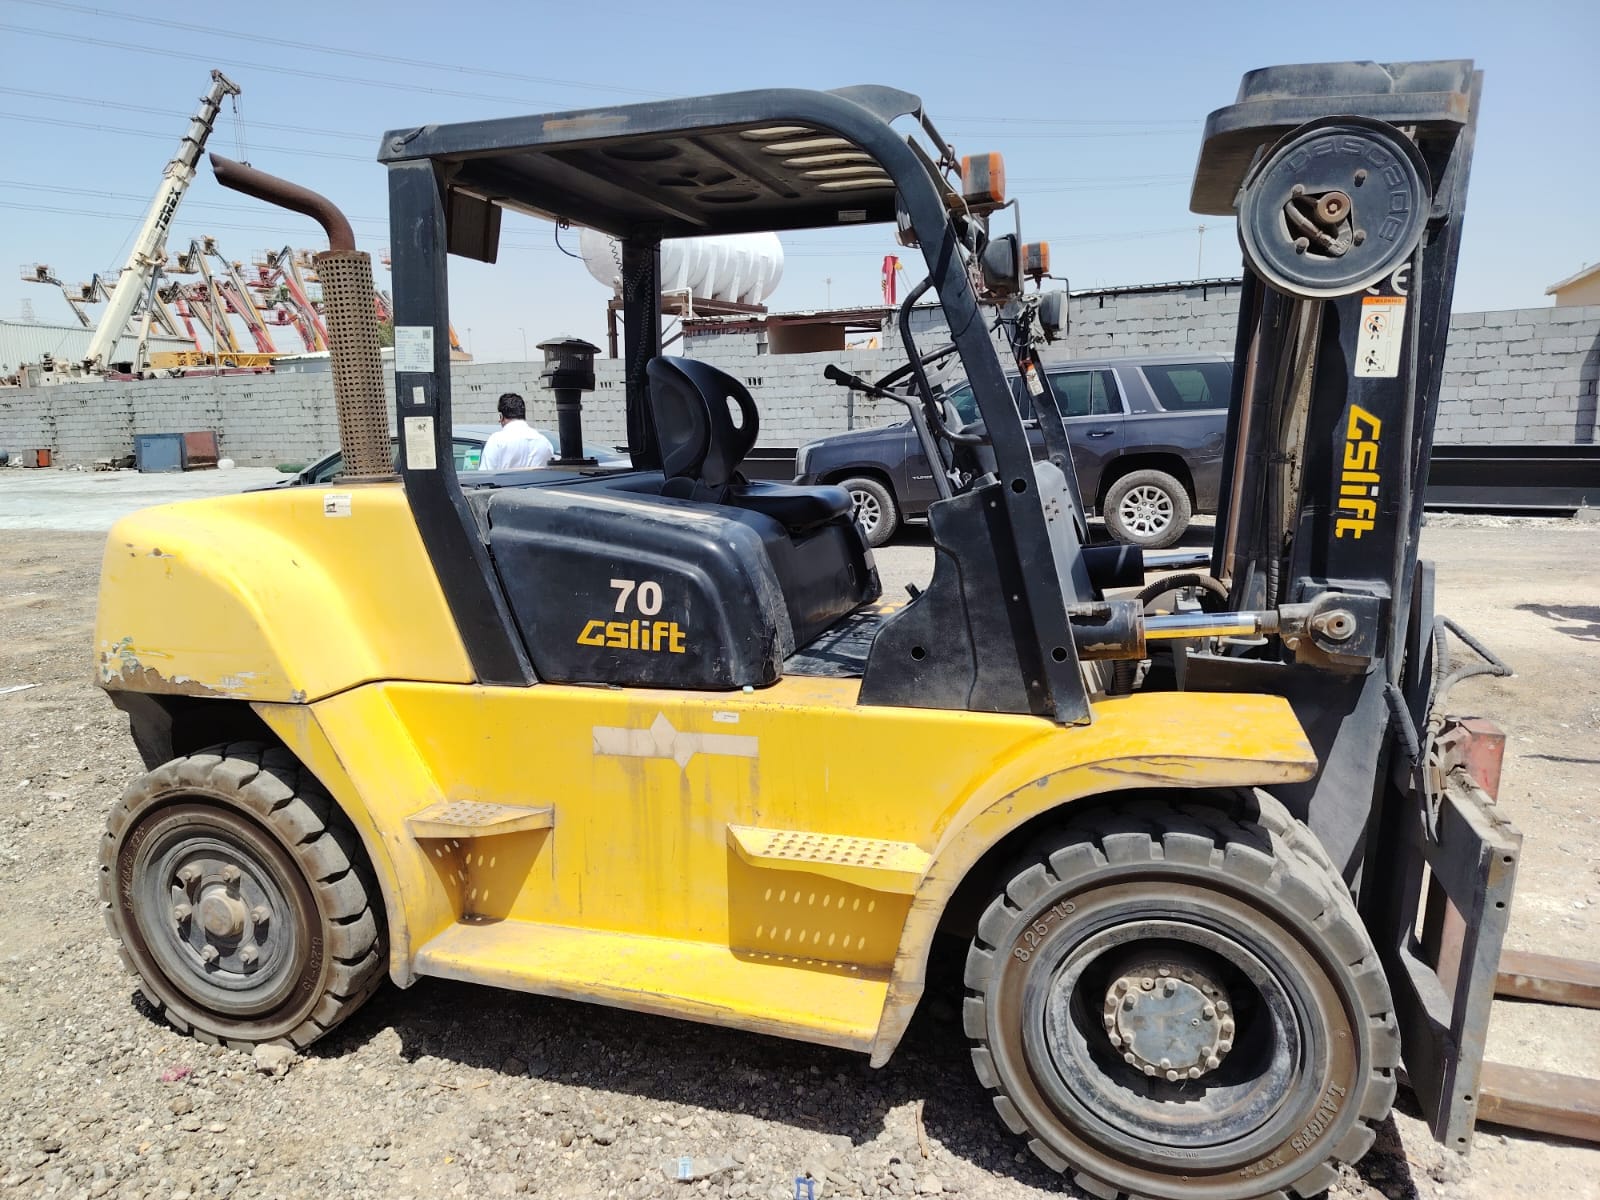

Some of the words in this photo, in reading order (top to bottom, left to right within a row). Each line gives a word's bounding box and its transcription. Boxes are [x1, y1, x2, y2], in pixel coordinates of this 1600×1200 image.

[155, 186, 182, 231] TEREX
[610, 578, 663, 616] 70
[1014, 901, 1076, 962] 8.25-15
[1291, 1080, 1346, 1154] LAUGFS
